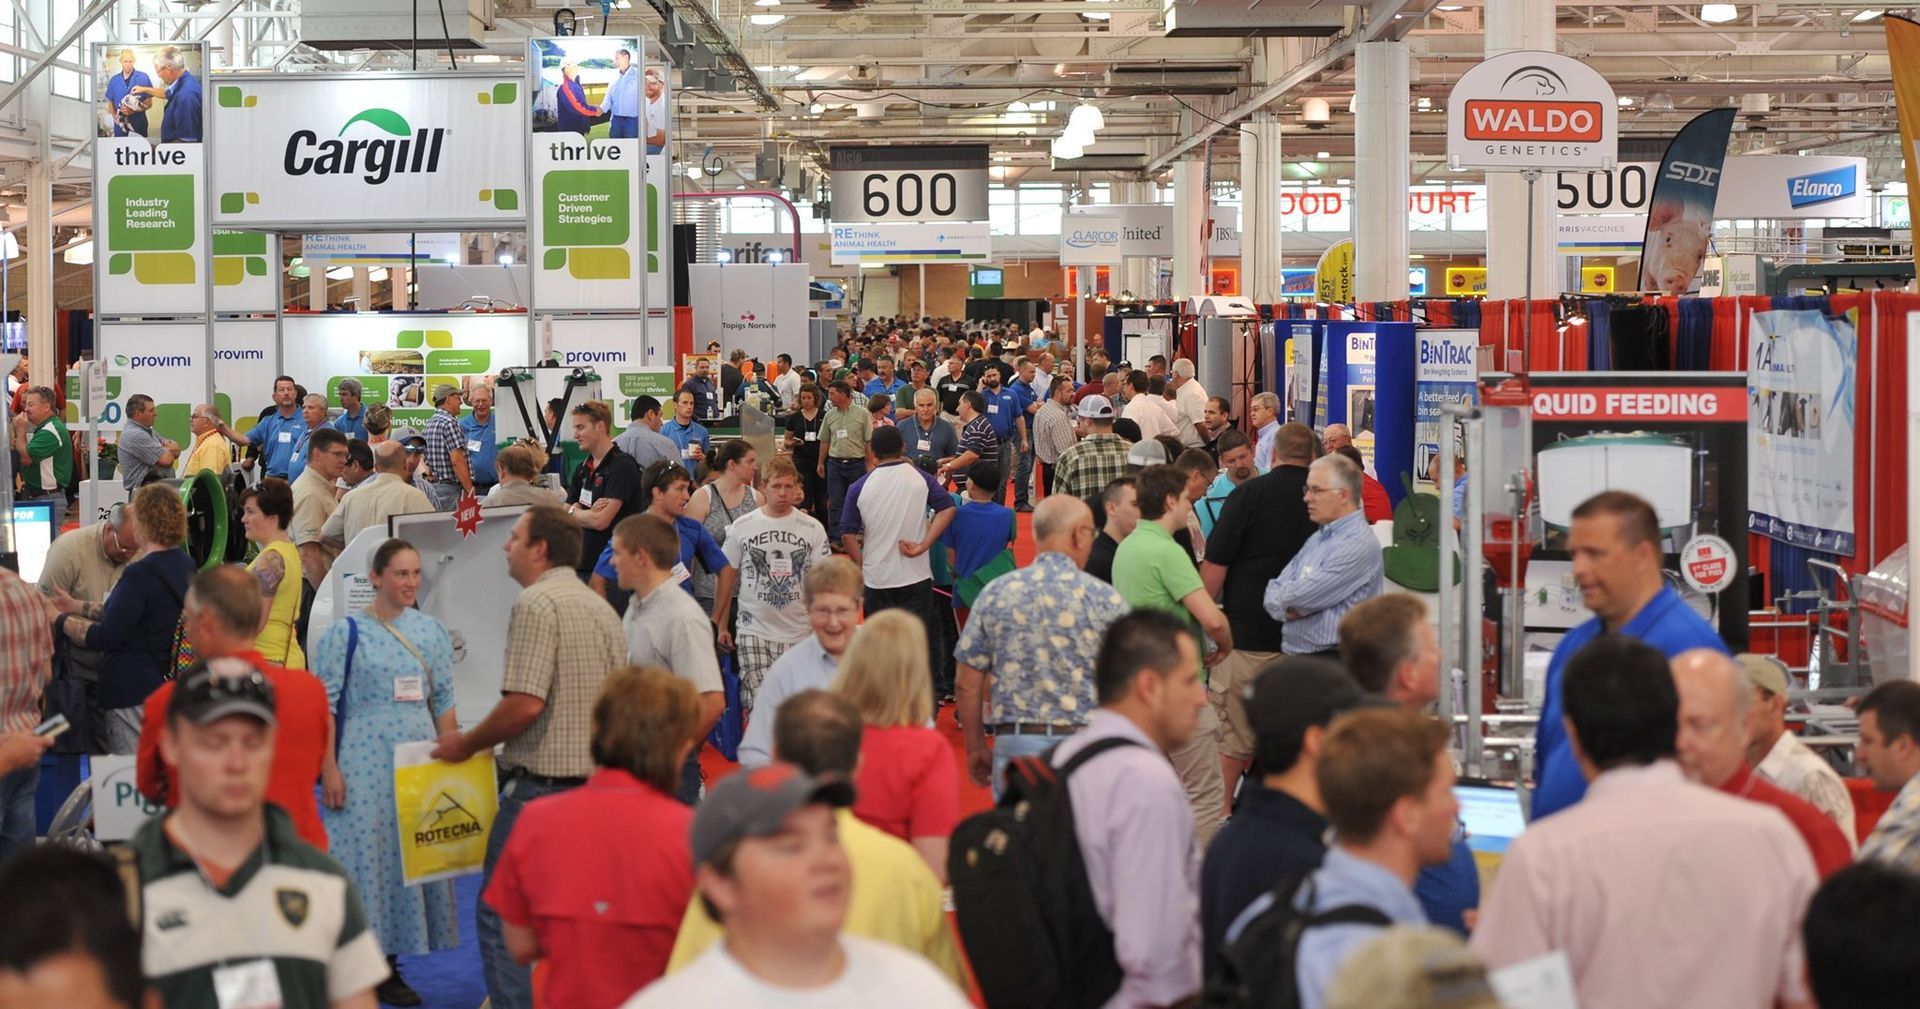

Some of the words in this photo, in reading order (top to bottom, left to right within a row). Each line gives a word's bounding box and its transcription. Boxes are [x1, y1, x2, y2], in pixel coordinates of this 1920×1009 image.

[1472, 108, 1593, 134] WALDO
[115, 146, 186, 166] thrive
[284, 128, 444, 185] Cargill
[550, 142, 621, 161] thrive
[1486, 145, 1581, 156] GENETICS
[1665, 160, 1719, 187] SDI
[863, 172, 957, 217] 600
[1557, 165, 1647, 209] 500
[1792, 178, 1842, 196] Elanco
[126, 198, 169, 208] Industry
[558, 193, 610, 202] Customer
[126, 208, 168, 220] Leading
[558, 204, 593, 212] Driven
[126, 219, 175, 229] Research
[558, 214, 613, 225] Strategies
[1073, 230, 1119, 240] CLARCOR
[131, 354, 191, 369] provimi
[566, 351, 626, 364] provimi
[1418, 391, 1424, 402] A
[1425, 391, 1445, 402] better
[1445, 391, 1460, 403] feed
[1605, 393, 1717, 416] FEEDING
[1418, 405, 1429, 416] bin
[460, 506, 475, 523] NEW
[742, 529, 813, 555] AMERICAN
[757, 591, 801, 603] FIGHTER
[414, 821, 483, 845] ROTECNA
